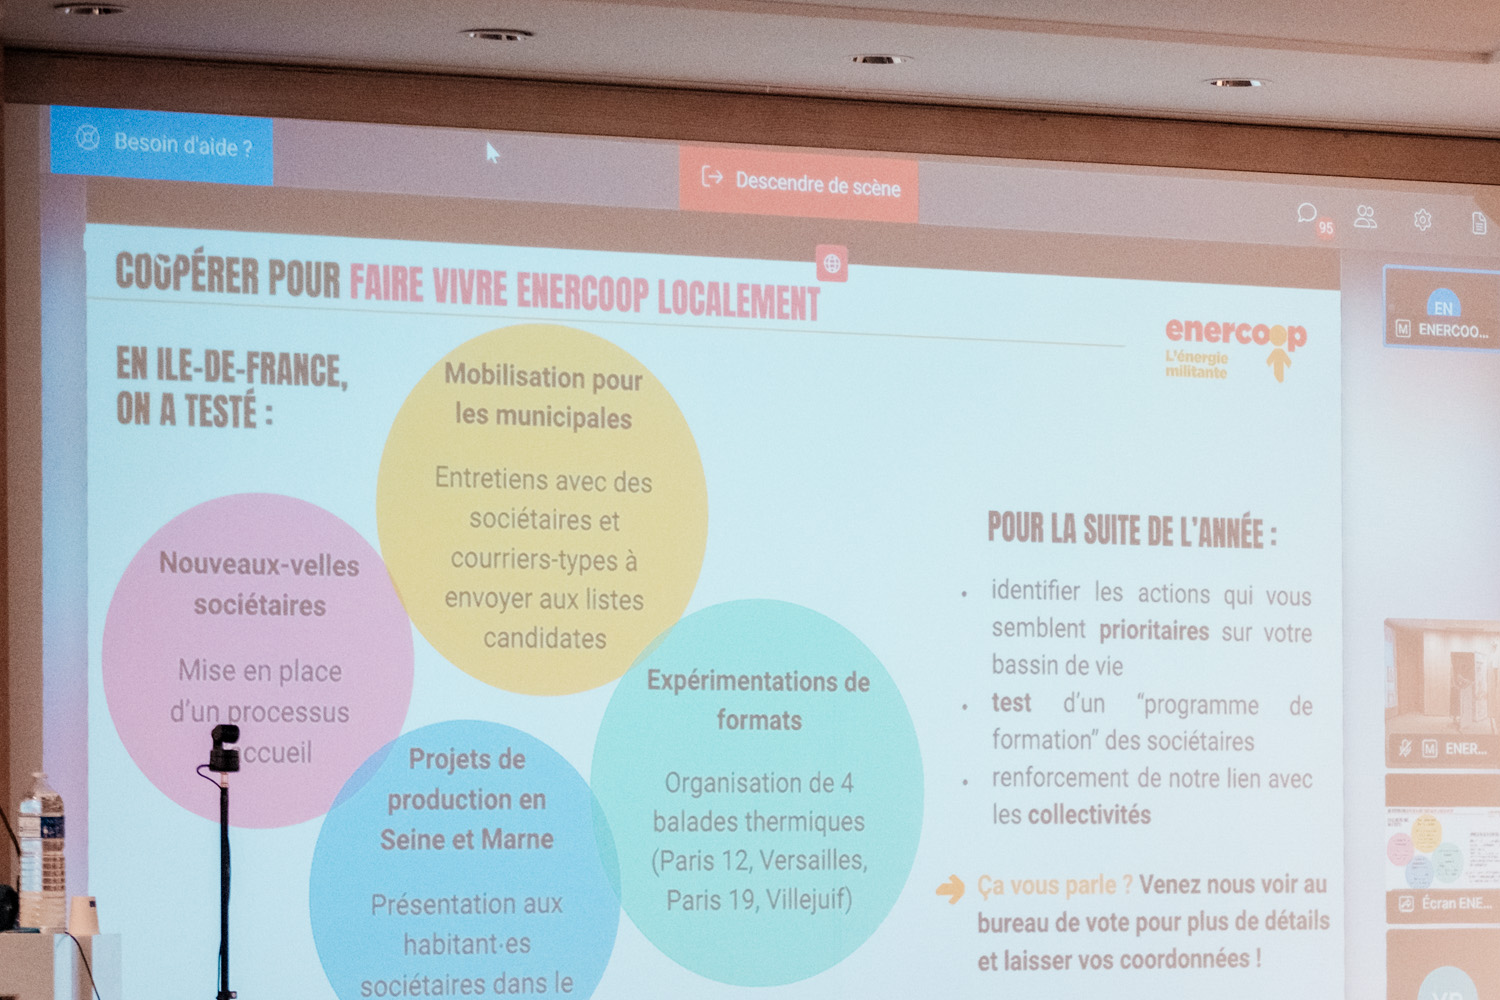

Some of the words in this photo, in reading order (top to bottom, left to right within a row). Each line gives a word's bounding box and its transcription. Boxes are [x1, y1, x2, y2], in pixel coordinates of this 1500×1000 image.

[115, 132, 178, 153] Besoin
[184, 135, 238, 157] d'aide
[736, 170, 824, 192] Descendre
[828, 177, 848, 194] de
[853, 179, 901, 197] scène
[1319, 221, 1333, 234] 95
[116, 245, 258, 295] COOPÉRER
[269, 259, 340, 298] POUR
[350, 263, 423, 302] FAIRE
[433, 267, 507, 306] VIVRE
[517, 271, 649, 313] ENERCOOP
[658, 279, 821, 321] LOCALEMENT
[1435, 301, 1453, 315] EN
[1166, 319, 1307, 352] enercoop
[117, 346, 147, 380] EN
[157, 347, 347, 391] ILE-DE-FRANCE,
[1166, 349, 1228, 366] L'énergie
[445, 362, 585, 389] Mobilisation
[593, 372, 643, 394] pour
[1166, 364, 1227, 379] militante
[117, 391, 150, 425] ON
[160, 393, 176, 426] A
[185, 387, 256, 428] TESTÉ
[456, 401, 489, 424] les
[496, 405, 632, 433] municipales
[436, 465, 548, 490] Entretiens
[556, 474, 606, 492] avec
[614, 470, 652, 493] des
[470, 507, 591, 531] sociétaires
[600, 512, 619, 531] et
[988, 510, 1044, 542] POUR
[1052, 512, 1076, 544] LA
[1084, 513, 1140, 546] SUITE
[1148, 515, 1173, 546] DE
[1181, 511, 1263, 549] L'ANNÉE
[160, 551, 359, 578] Nouveaux-velles
[451, 548, 618, 576] courriers-types
[194, 593, 326, 616] sociétaires
[445, 590, 533, 614] envoyer
[540, 593, 578, 610] aux
[587, 588, 644, 611] listes
[484, 626, 607, 649] candidates
[179, 658, 236, 682] Mise
[244, 662, 271, 682] en
[279, 659, 342, 687] place
[647, 668, 838, 695] Expérimentations
[845, 671, 870, 693] de
[171, 699, 219, 722] d'un
[228, 704, 350, 725] processus
[717, 707, 803, 731] formats
[409, 747, 491, 775] Projets
[499, 747, 526, 769] de
[665, 771, 801, 798] Organisation
[809, 771, 834, 793] de
[841, 772, 854, 793] 4
[388, 787, 512, 815] production
[519, 792, 546, 810] en
[654, 809, 738, 832] balades
[745, 810, 865, 836] thermiques
[380, 828, 445, 850] Seine
[452, 830, 474, 850] et
[482, 828, 554, 850] Marne
[651, 848, 714, 877] (Paris
[723, 850, 753, 874] 12,
[760, 849, 867, 873] Versailles,
[667, 889, 721, 911] Paris
[730, 889, 759, 913] 19,
[767, 887, 852, 914] Villejuif)
[977, 874, 1004, 901] Ça
[1011, 878, 1060, 895] vous
[1066, 873, 1117, 900] parle
[1140, 873, 1201, 895] Venez
[1207, 875, 1256, 895] nous
[1261, 873, 1298, 894] voir
[1304, 875, 1328, 894] au
[372, 893, 516, 915] Présentation
[524, 896, 563, 914] aux
[1422, 894, 1456, 910] Écran
[978, 912, 1049, 934] bureau
[1055, 911, 1080, 933] de
[1086, 915, 1130, 933] vote
[1136, 915, 1181, 937] pour
[1187, 910, 1229, 936] plus
[1235, 911, 1259, 931] de
[1265, 909, 1330, 931] détails
[978, 952, 998, 971] et
[1005, 950, 1072, 971] laisser
[1079, 952, 1114, 970] vos
[1120, 947, 1250, 970] coordonnées
[361, 973, 485, 997] sociétaires
[493, 971, 547, 994] dans
[555, 971, 573, 993] le
